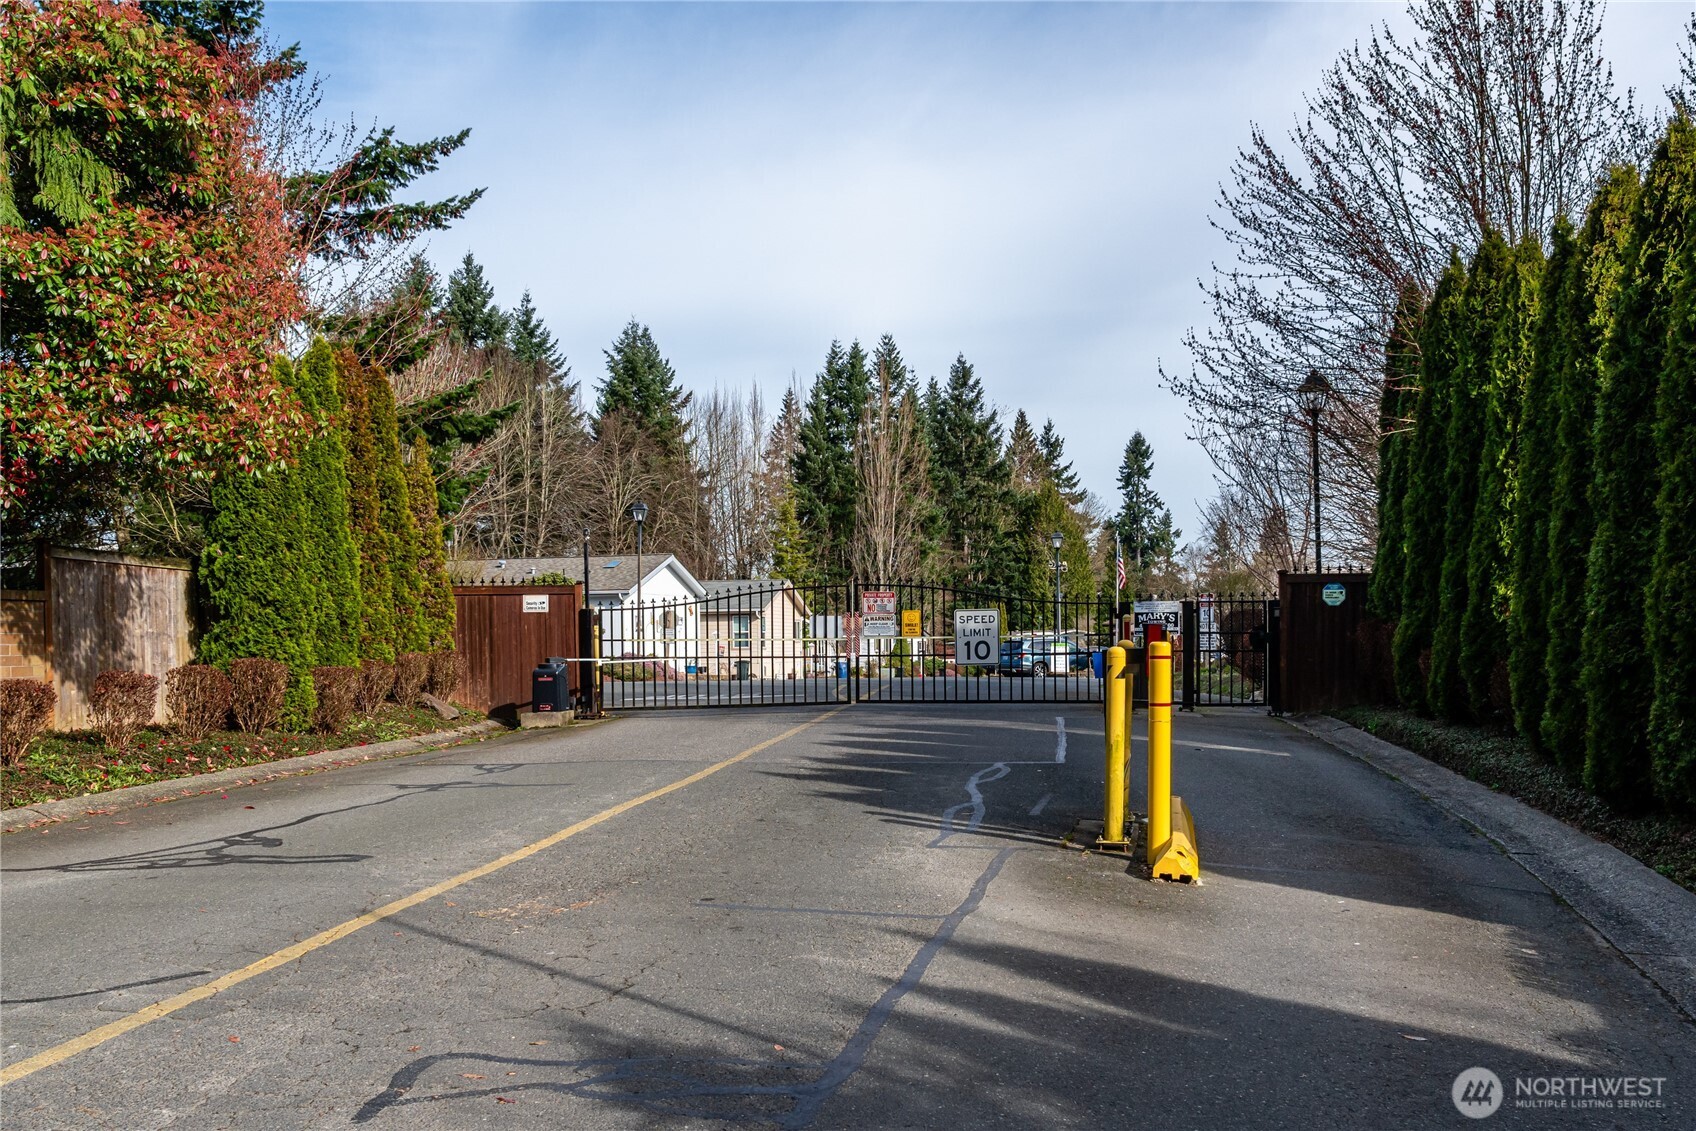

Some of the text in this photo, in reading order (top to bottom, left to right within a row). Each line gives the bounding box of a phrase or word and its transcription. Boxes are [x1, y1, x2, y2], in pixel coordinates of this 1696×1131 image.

[867, 604, 876, 612] NO
[959, 615, 995, 624] SPEED
[1138, 612, 1176, 623] MARY'S
[963, 628, 991, 637] LIMIT
[964, 640, 991, 660] 10
